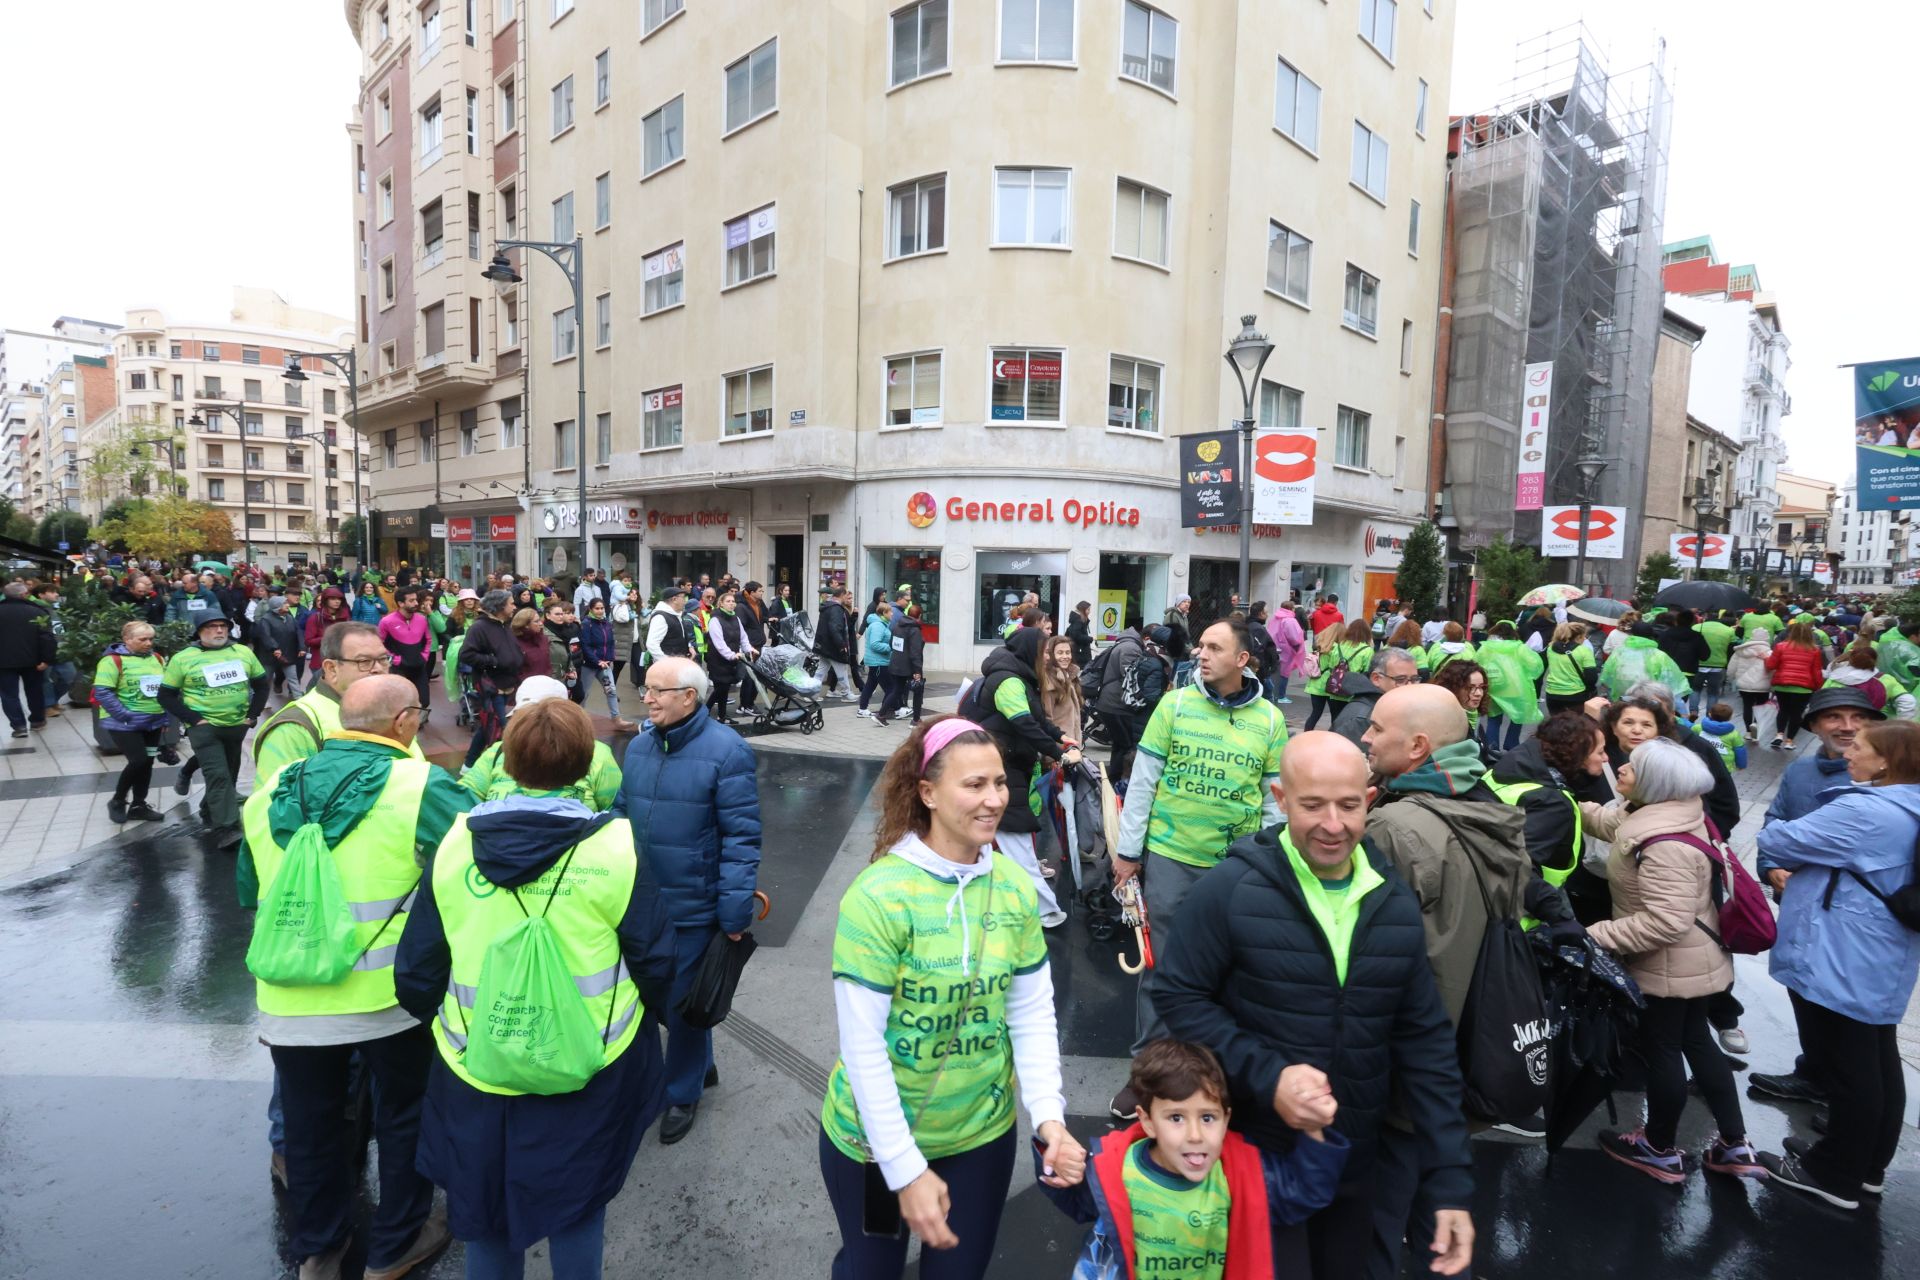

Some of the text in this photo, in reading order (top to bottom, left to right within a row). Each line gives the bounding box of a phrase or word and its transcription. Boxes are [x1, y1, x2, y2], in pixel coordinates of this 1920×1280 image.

[1522, 476, 1540, 485] 983
[1279, 486, 1307, 494] SEMINCI
[1521, 486, 1539, 495] 278
[659, 511, 695, 527] General
[946, 496, 1140, 528] General Optica
[214, 669, 239, 681] 2668
[1184, 730, 1224, 742] Valladolid
[1171, 740, 1263, 771] En marcha
[1170, 760, 1226, 781] contra
[1166, 774, 1246, 801] el cáncer
[901, 977, 938, 1004] En
[894, 1035, 922, 1061] el
